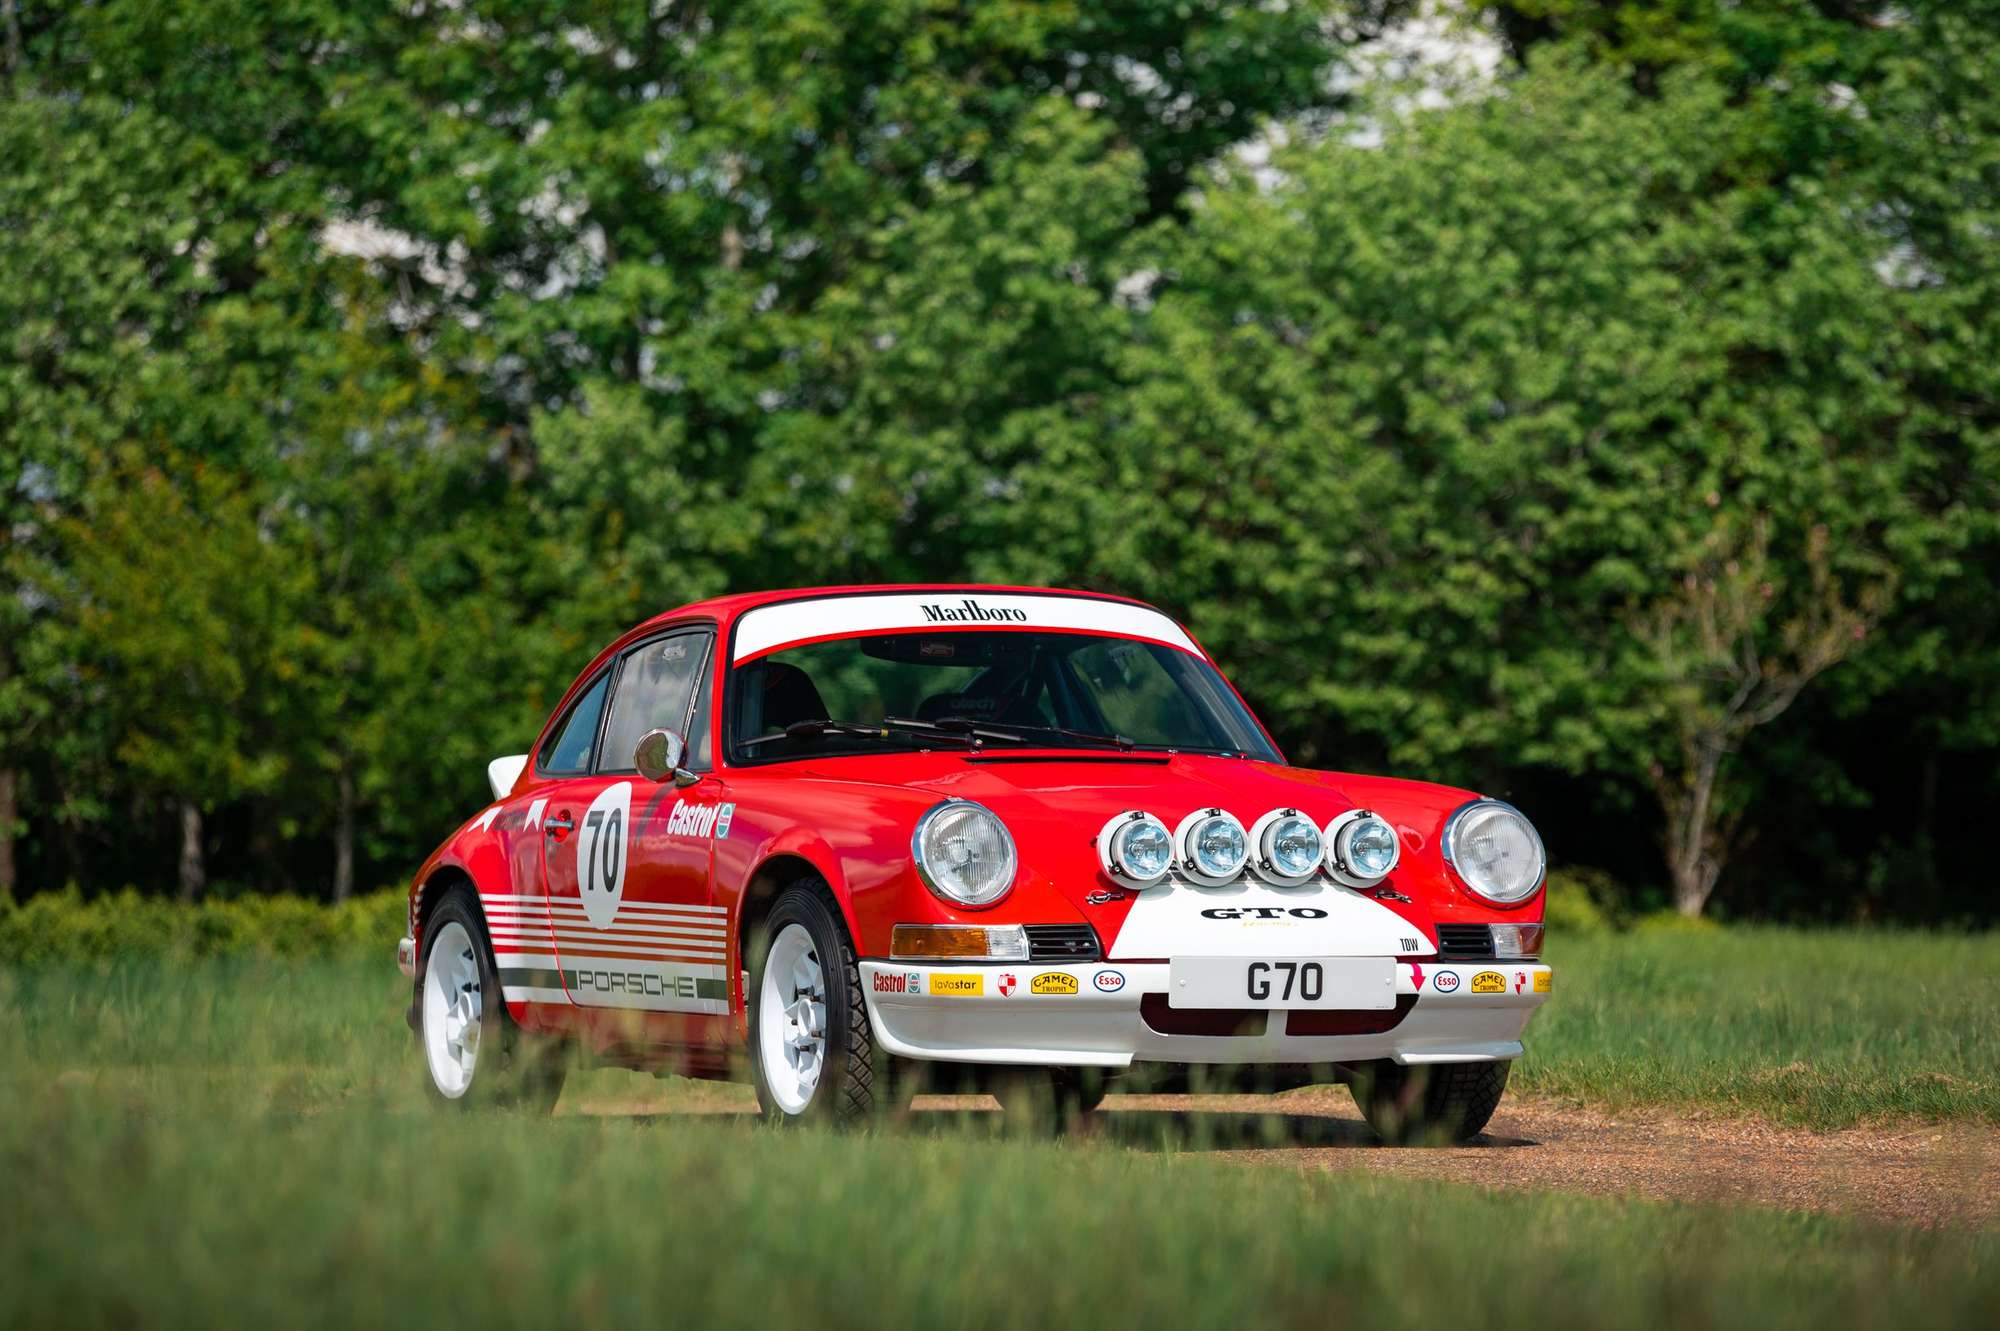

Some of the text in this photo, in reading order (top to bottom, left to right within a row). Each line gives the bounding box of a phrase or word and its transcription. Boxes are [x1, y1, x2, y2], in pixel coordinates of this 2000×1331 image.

[920, 599, 1027, 622] Marlboro
[667, 798, 721, 838] Castrol
[587, 807, 621, 893] 70
[1201, 908, 1329, 919] GTO
[1400, 938, 1418, 952] TOW
[578, 970, 695, 998] PORSCHE
[873, 971, 906, 993] Castrol
[1033, 975, 1076, 989] CAMEL
[1247, 962, 1323, 1001] G70
[1473, 974, 1504, 987] CAMEL
